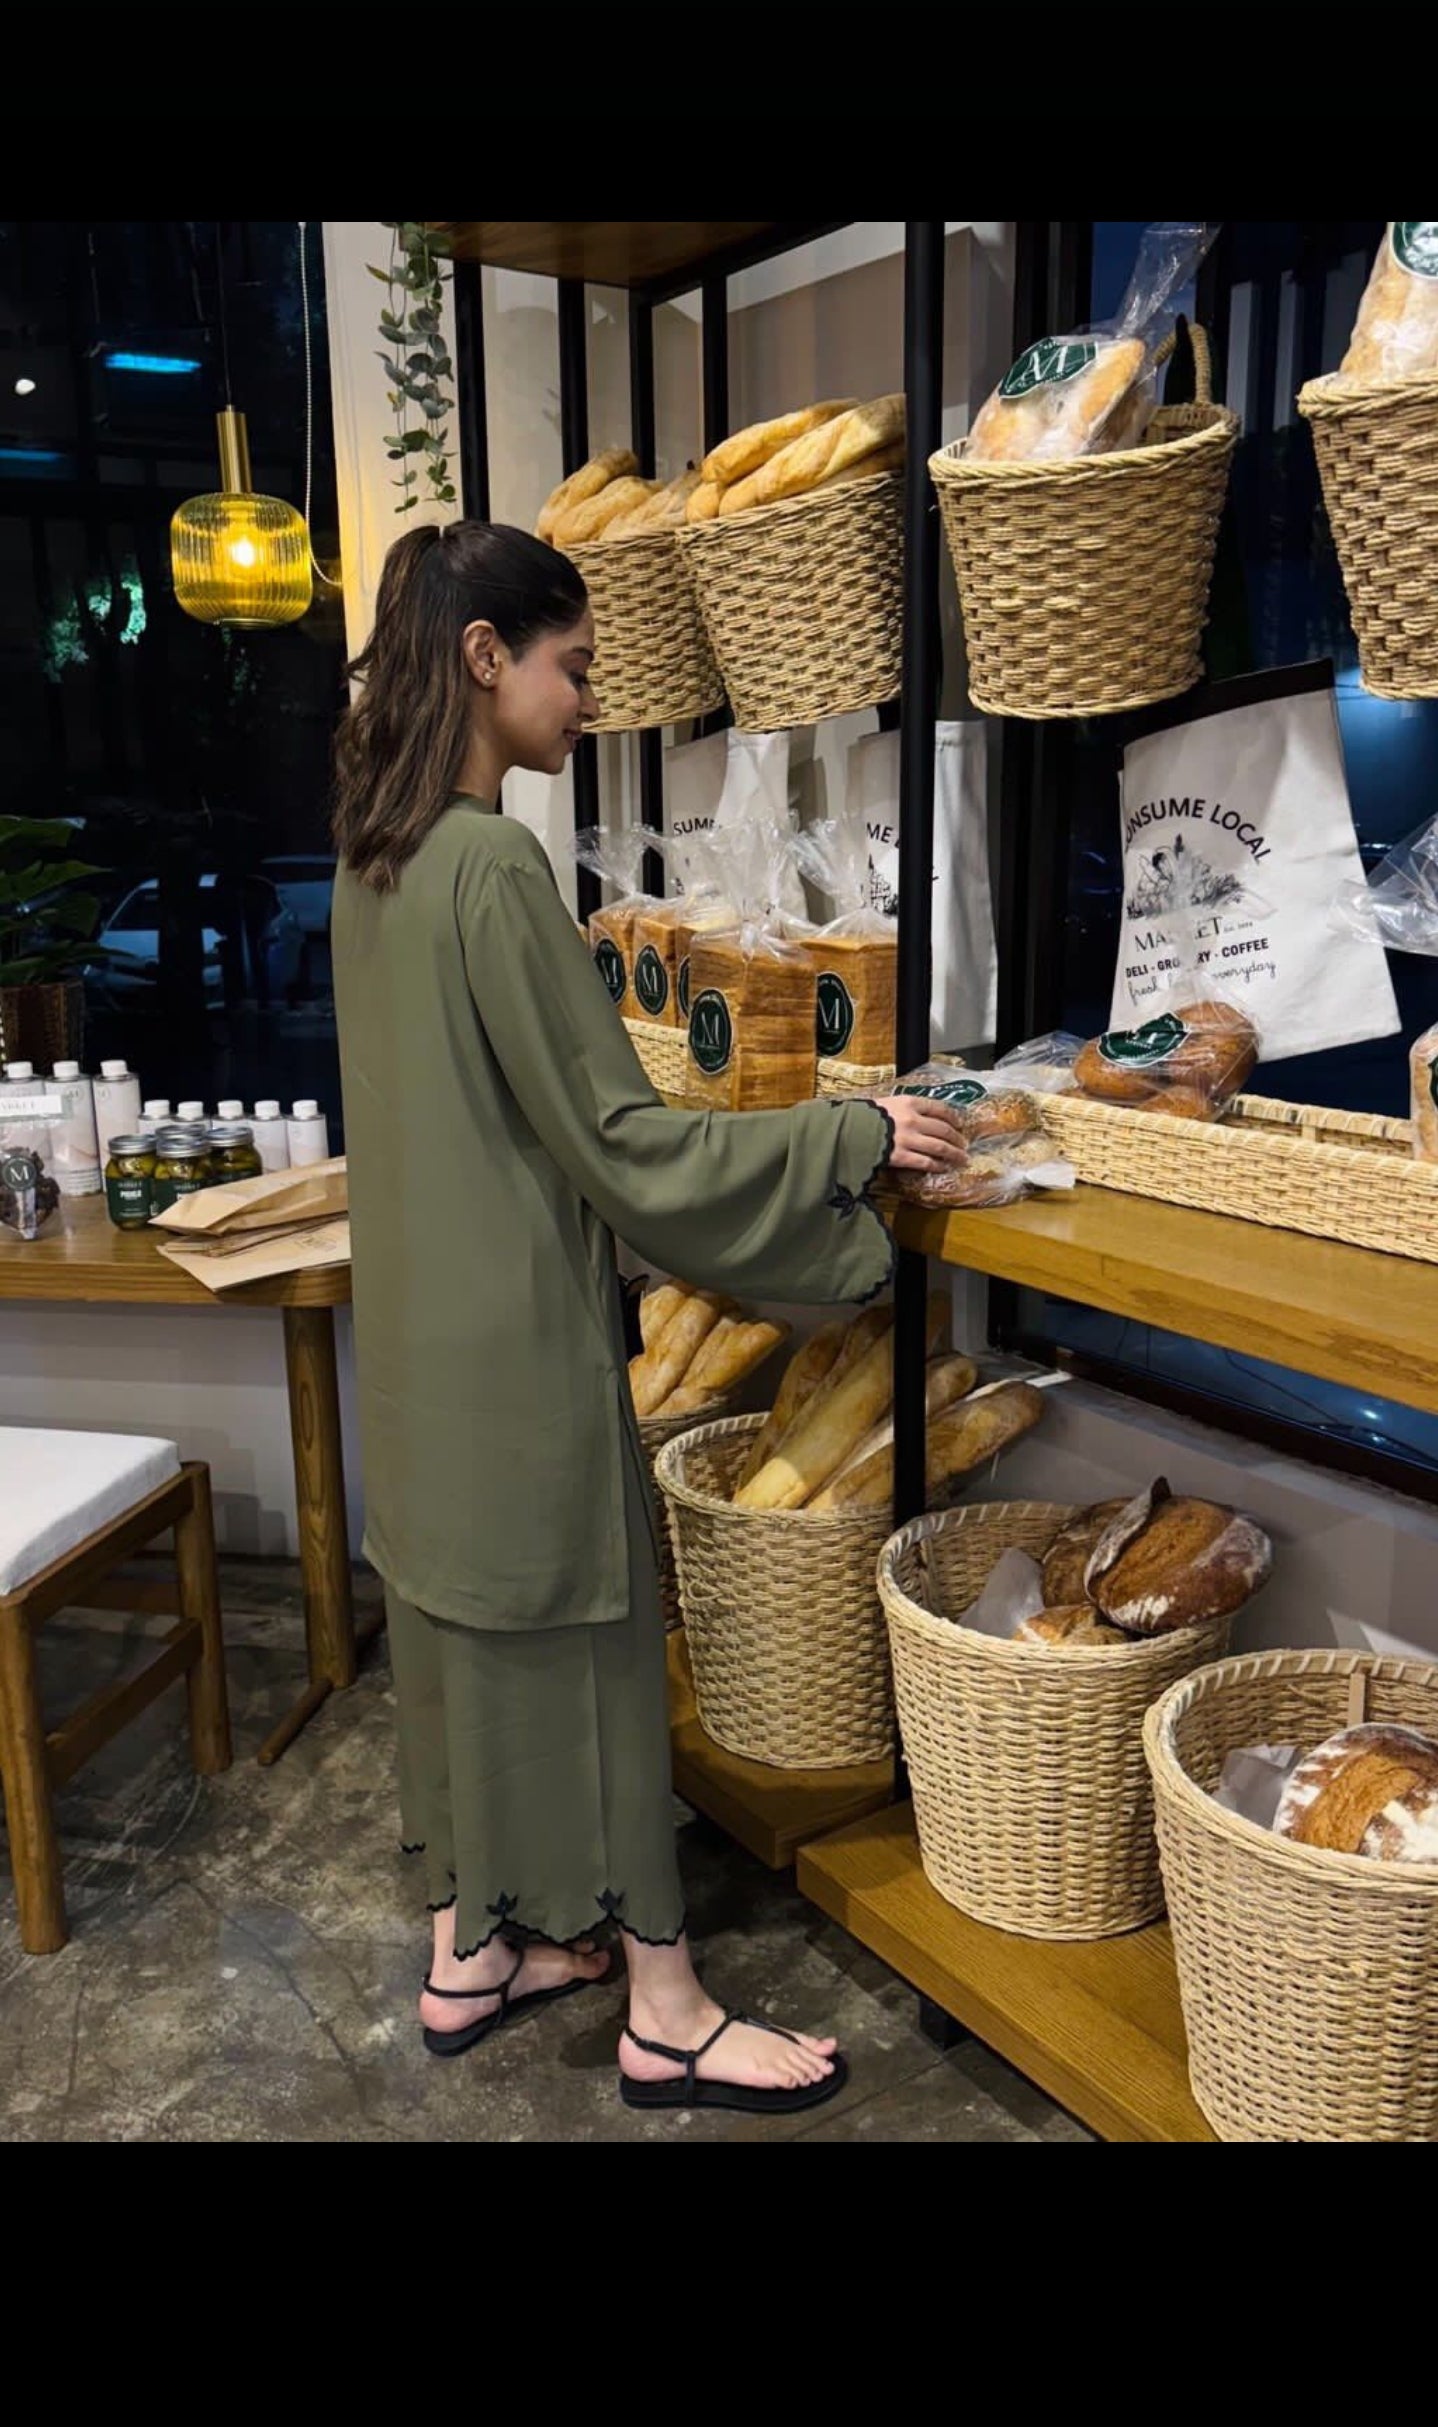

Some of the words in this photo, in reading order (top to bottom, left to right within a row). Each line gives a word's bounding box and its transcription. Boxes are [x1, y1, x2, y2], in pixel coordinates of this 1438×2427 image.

[1125, 797, 1206, 853] ONSUME
[1210, 803, 1272, 865] LOCAL
[1125, 964, 1149, 979] DELI
[1221, 938, 1270, 958] COFFEE
[9, 1164, 30, 1182] M
